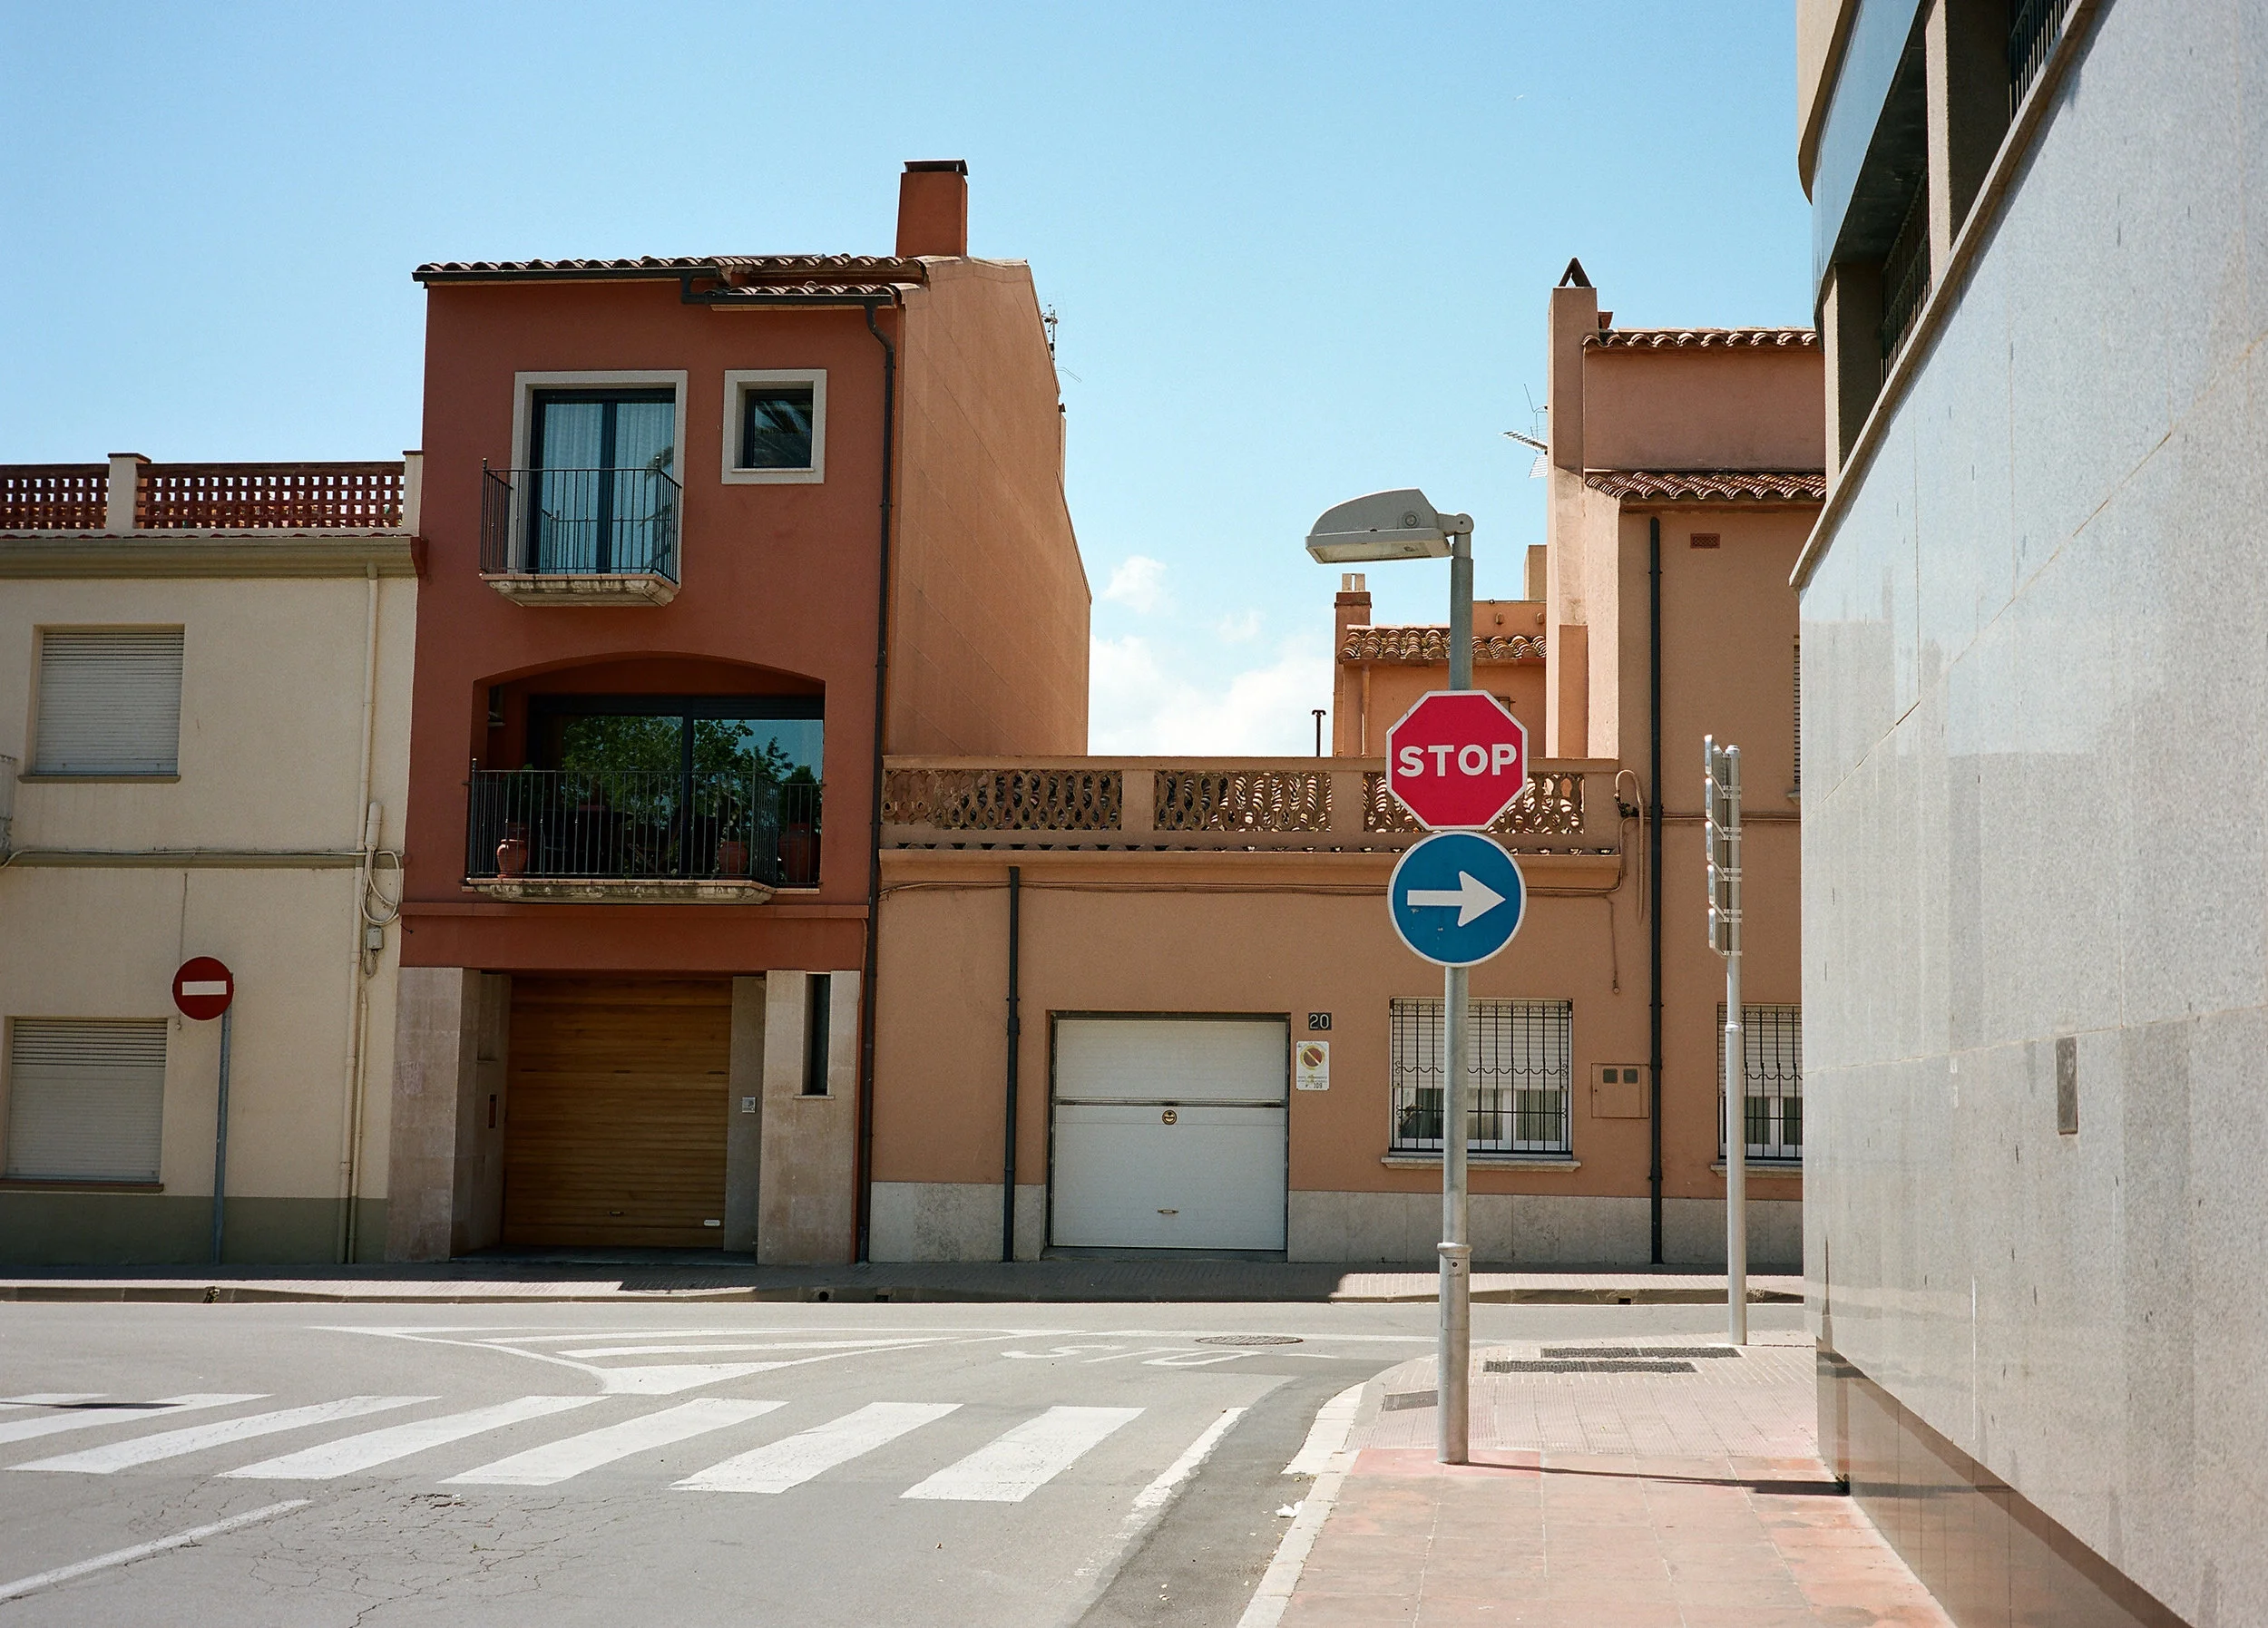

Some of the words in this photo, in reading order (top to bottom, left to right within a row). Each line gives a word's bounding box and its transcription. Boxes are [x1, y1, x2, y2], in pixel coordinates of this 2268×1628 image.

[1397, 744, 1517, 777] STOP
[1309, 1014, 1329, 1029] 20
[1001, 1345, 1341, 1366] STO
